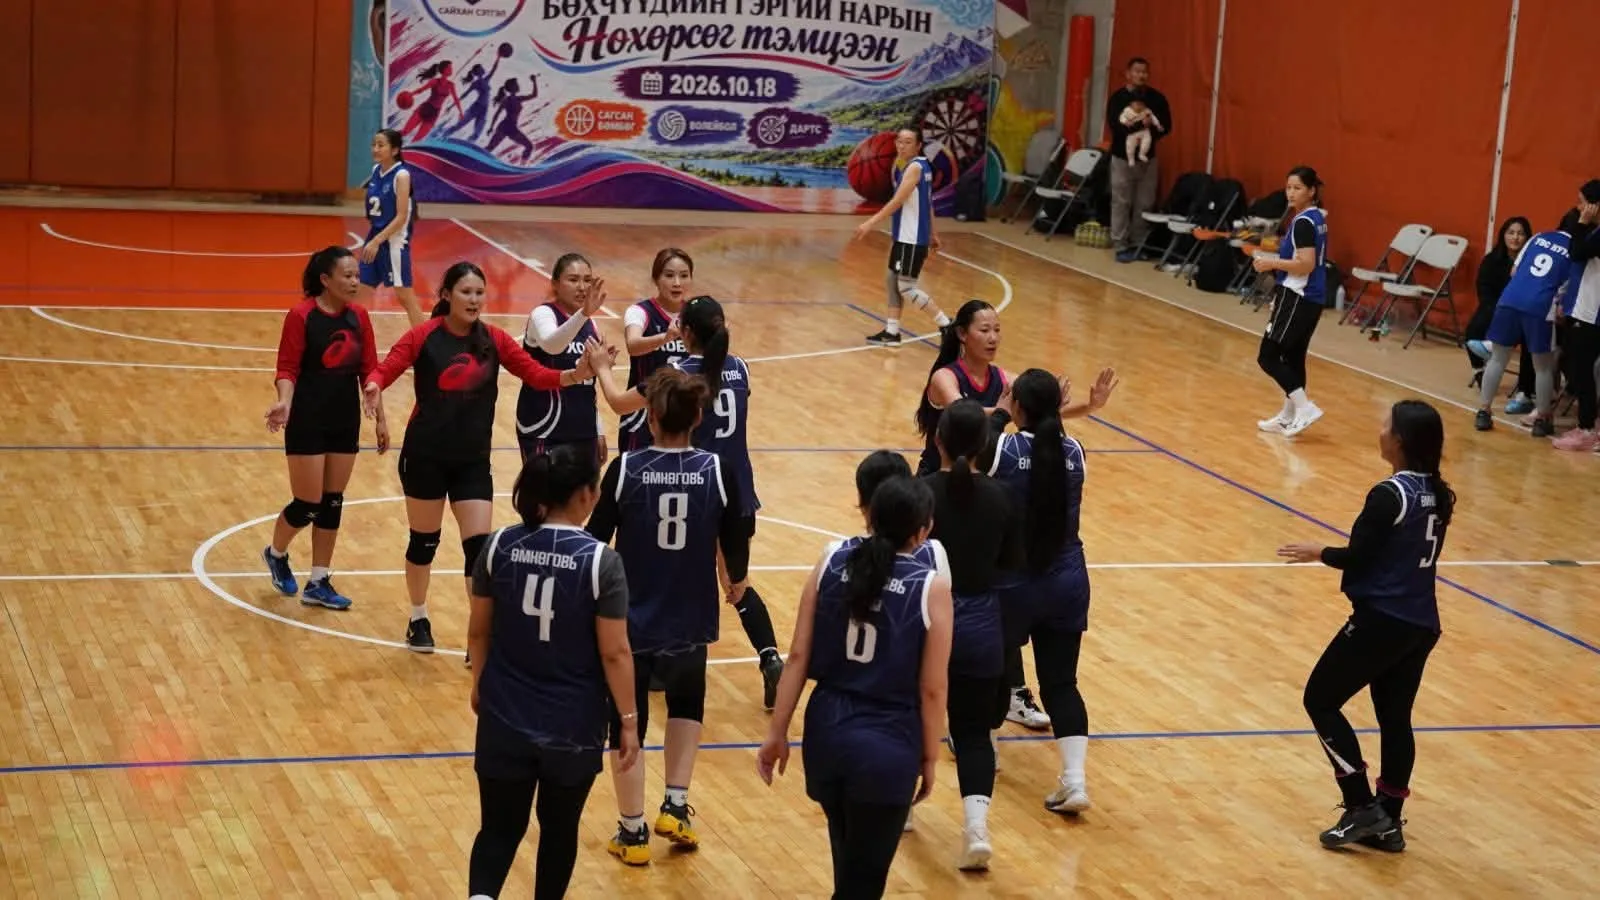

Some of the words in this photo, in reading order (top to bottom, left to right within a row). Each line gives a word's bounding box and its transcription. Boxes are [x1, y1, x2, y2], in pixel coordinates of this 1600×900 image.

[839, 3, 932, 34] НАРЫН
[562, 15, 736, 64] Нөхөрсөг
[741, 24, 899, 65] тэмцээн
[669, 74, 777, 97] 2026.10.18
[598, 111, 634, 121] САГСАН
[689, 120, 737, 131] ВОЛЕЙБОЛ
[789, 124, 822, 135] ДАРТС
[368, 196, 382, 217] 2
[1530, 253, 1553, 277] 9
[713, 388, 737, 438] 9
[642, 471, 705, 485] ӨМНӨГОВЬ
[657, 492, 689, 550] 8
[1419, 514, 1443, 569] 5
[510, 548, 577, 571] ӨМНӨГОВЬ
[521, 574, 555, 642] 4
